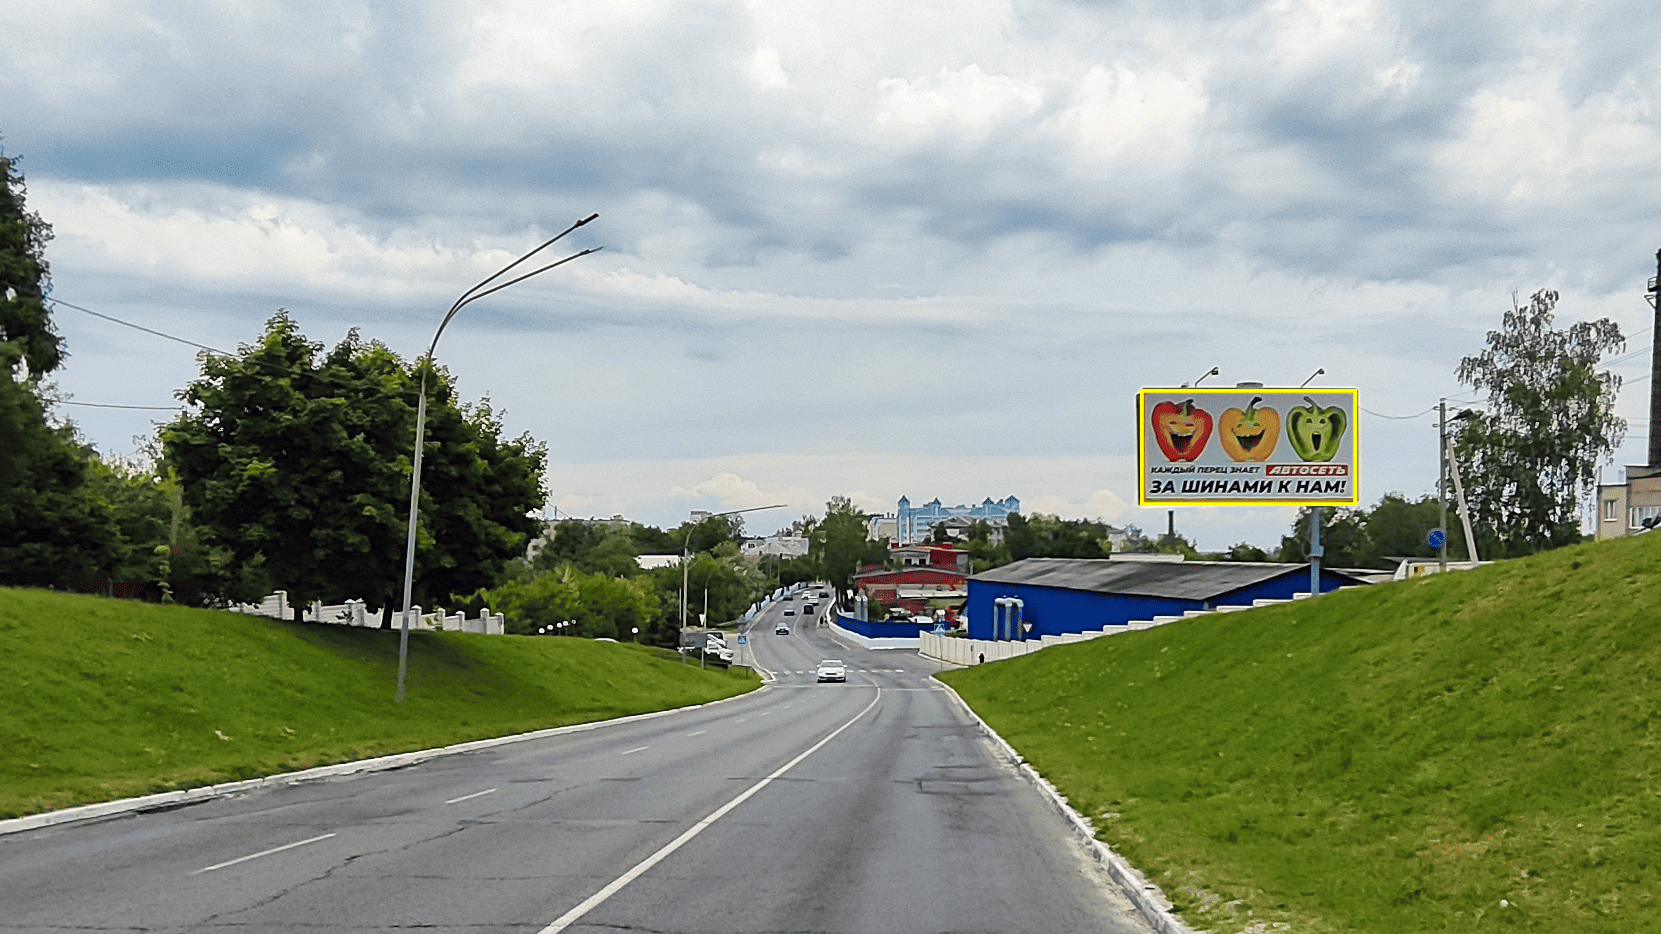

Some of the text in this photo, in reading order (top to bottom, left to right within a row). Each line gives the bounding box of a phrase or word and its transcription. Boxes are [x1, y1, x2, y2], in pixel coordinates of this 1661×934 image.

[1150, 465, 1346, 475] КАЖДЫЙ ПЕРЕЦ ЗНАЕТ АВТОСЕТЬ
[1149, 480, 1347, 493] ЗА ШИНАМИ К НАМ!
